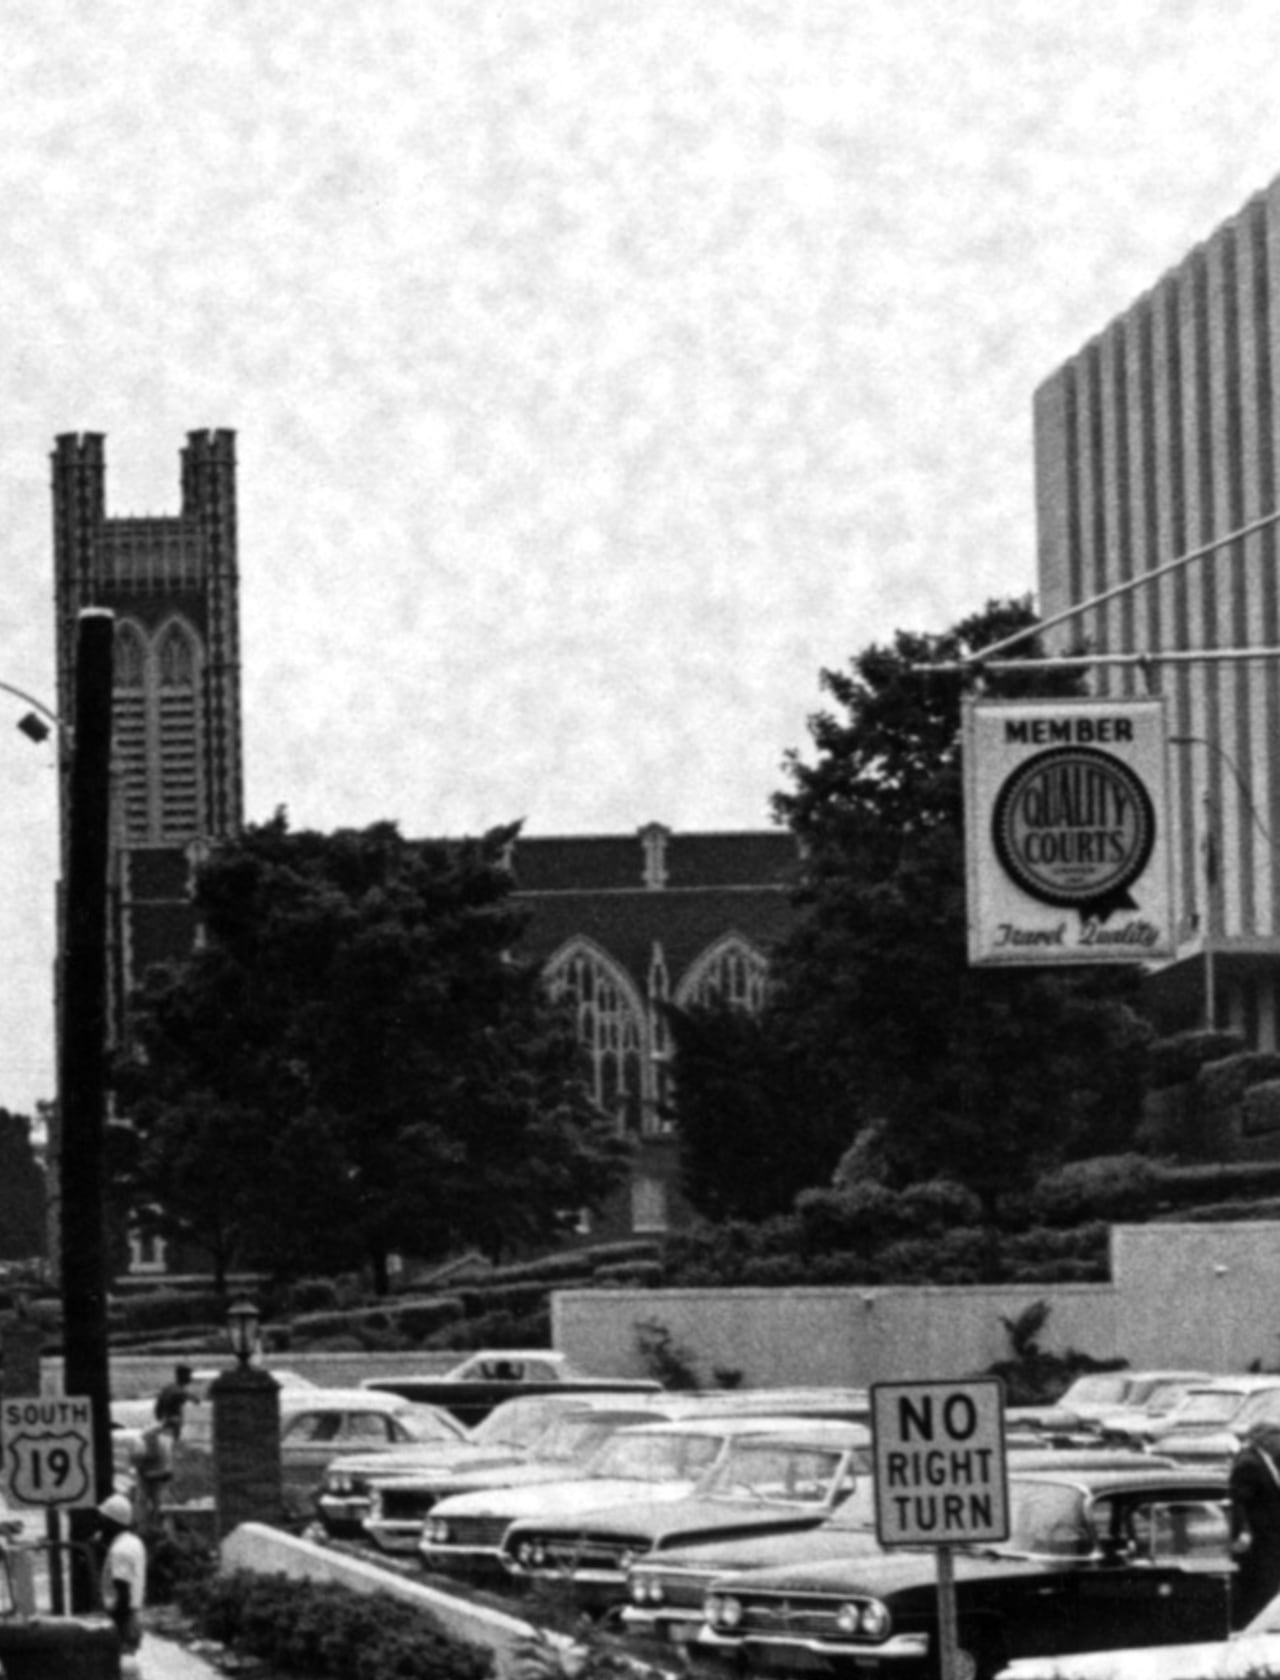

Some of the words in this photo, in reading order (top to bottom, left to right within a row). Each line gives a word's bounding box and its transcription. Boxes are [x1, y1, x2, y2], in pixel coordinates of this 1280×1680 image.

[1005, 719, 1133, 744] MEMBER
[1023, 766, 1129, 829] QUALITY
[1024, 830, 1126, 864] COURTS
[994, 921, 1068, 947] Travel
[1079, 918, 1160, 947] Quality
[6, 1402, 88, 1425] SOUTH
[899, 1393, 977, 1442] NO
[31, 1447, 71, 1490] 19
[888, 1449, 993, 1487] RIGHT
[894, 1494, 993, 1531] TURN
